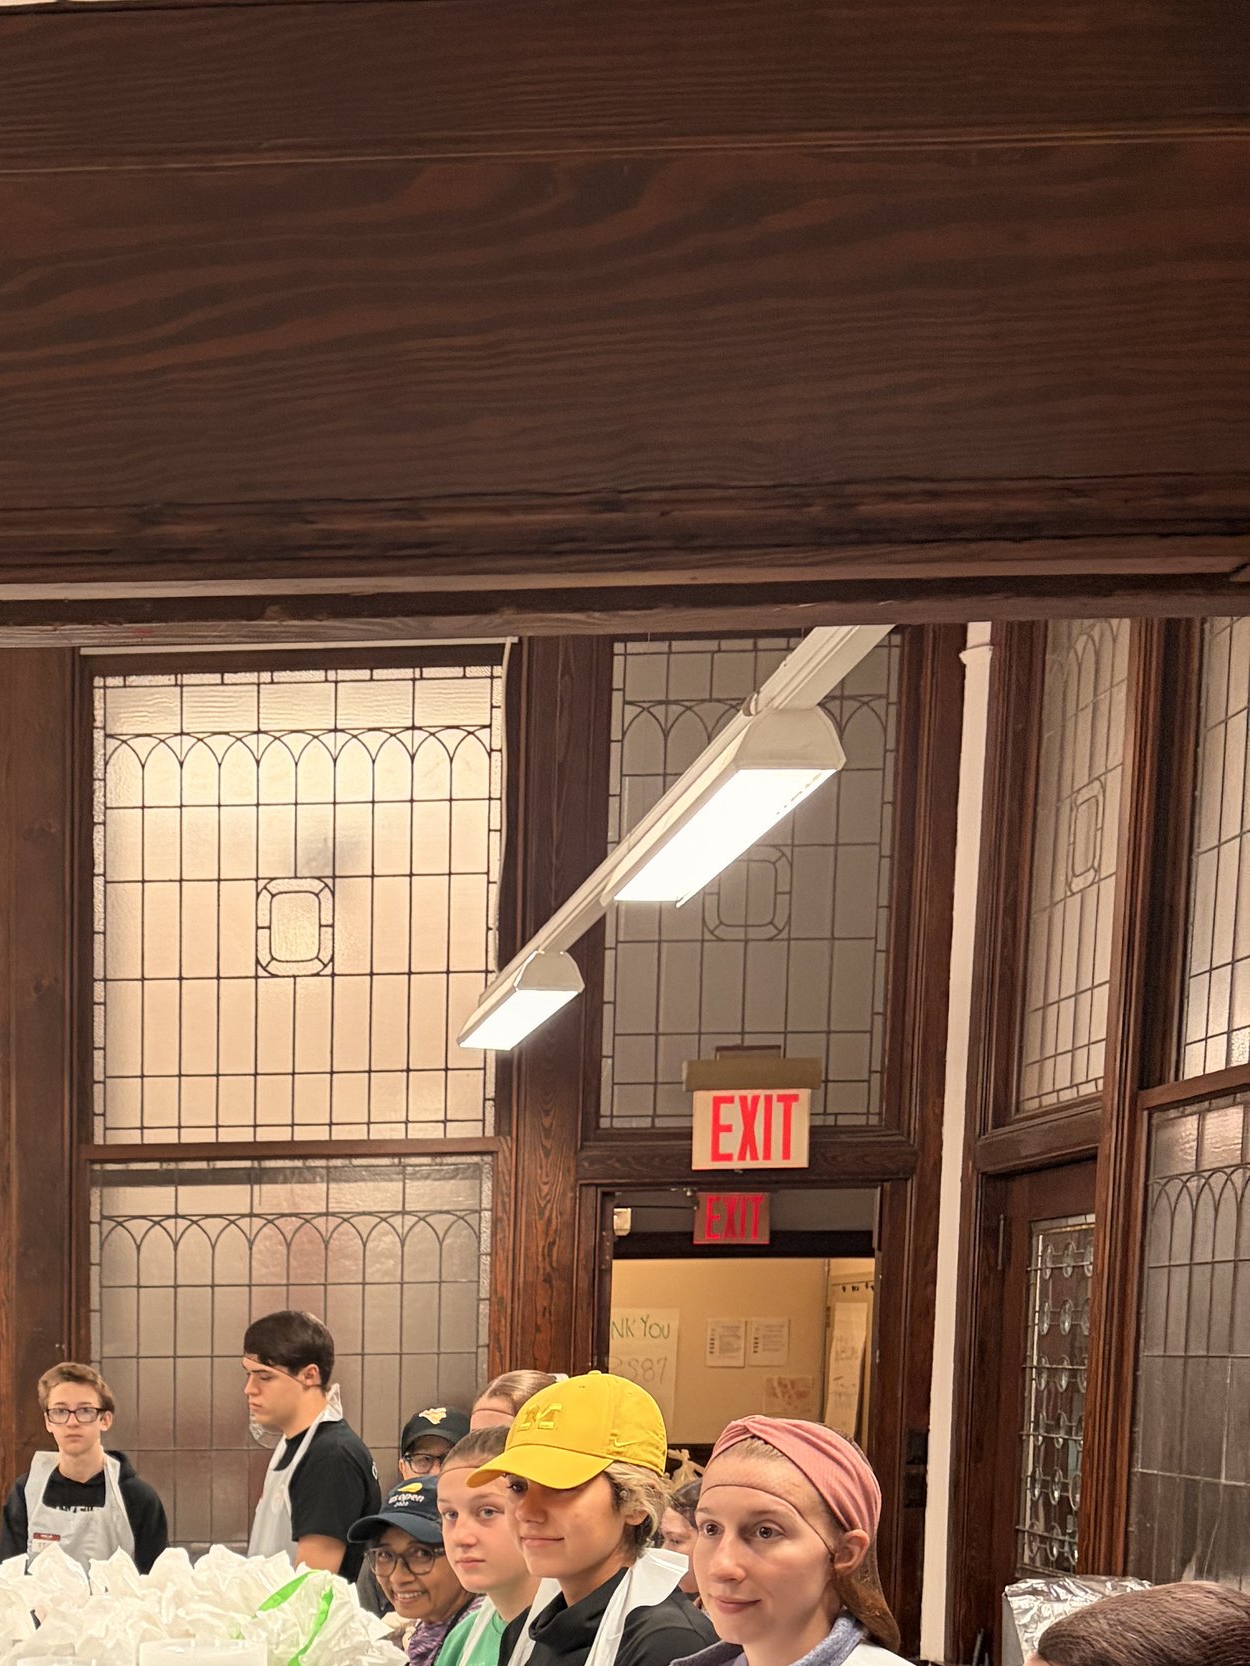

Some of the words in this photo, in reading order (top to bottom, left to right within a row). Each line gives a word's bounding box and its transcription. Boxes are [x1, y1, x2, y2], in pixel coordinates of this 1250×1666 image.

[711, 1094, 799, 1162] EXIT
[705, 1195, 763, 1240] EXIT
[640, 1314, 670, 1339] YOU
